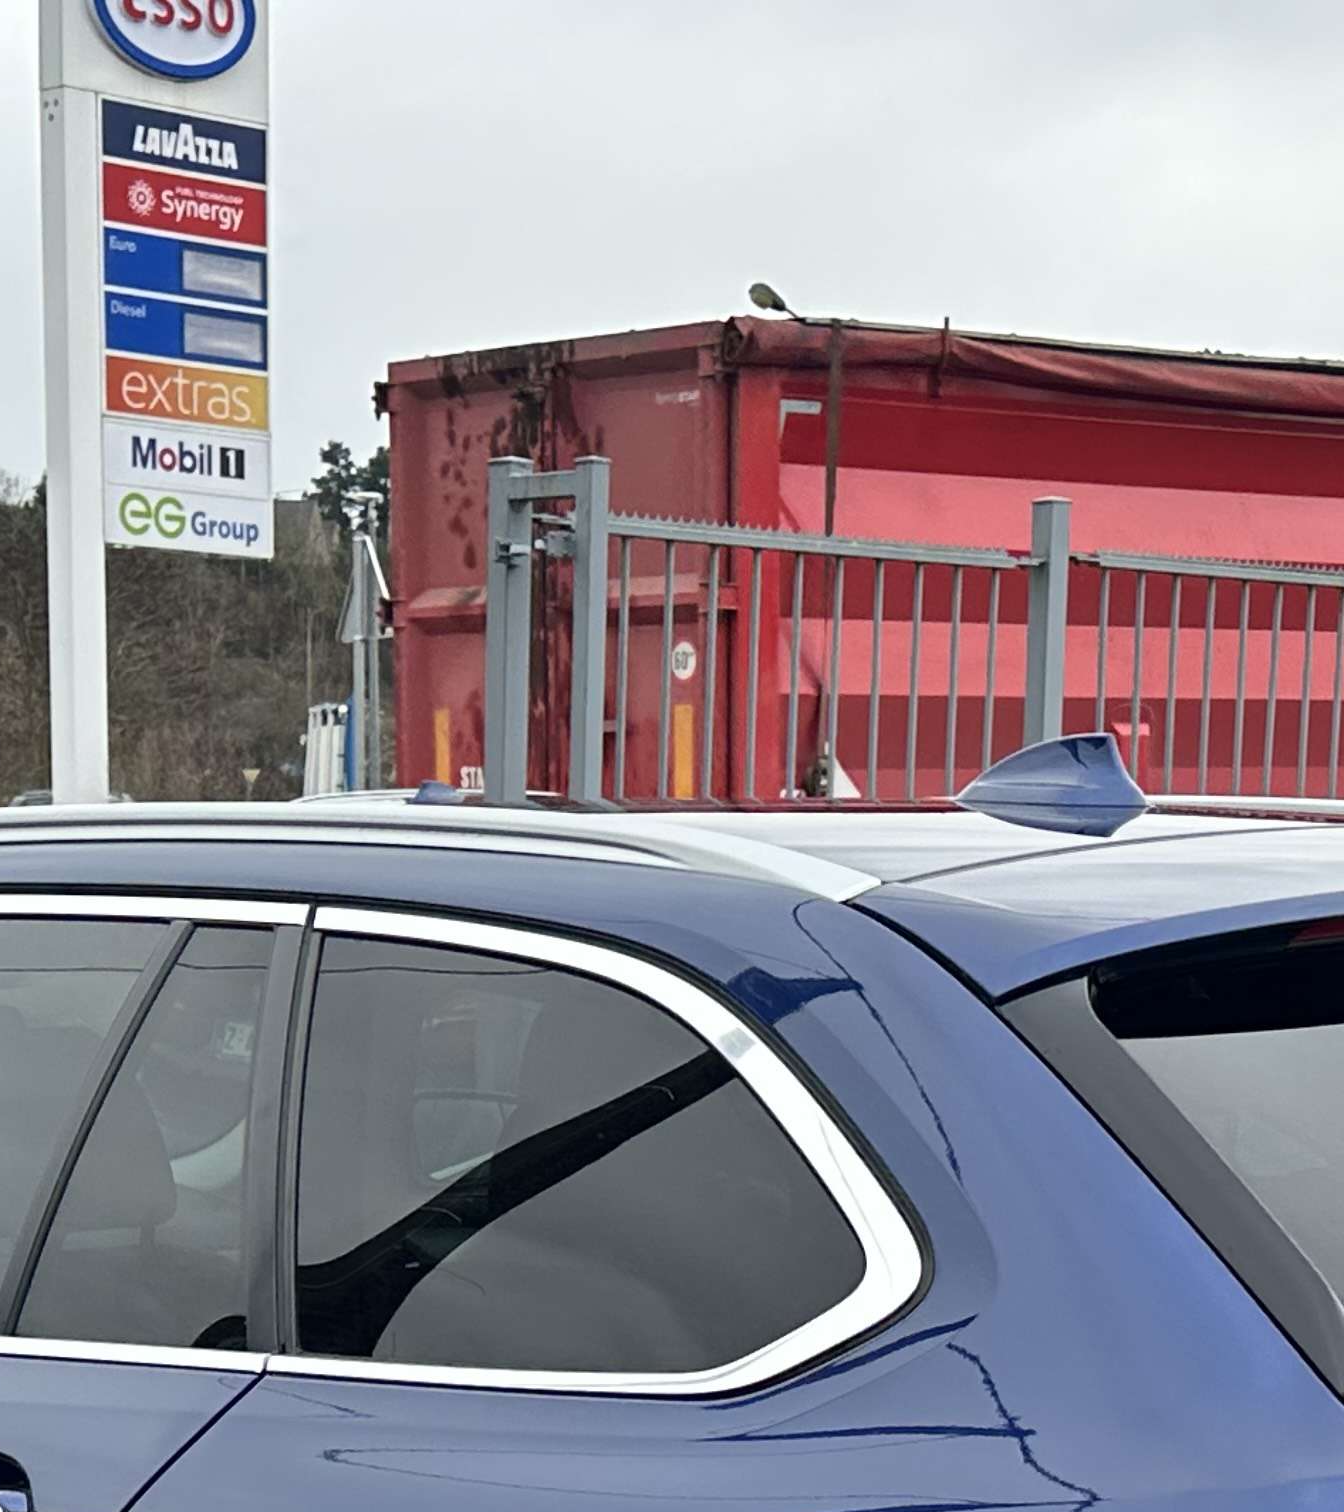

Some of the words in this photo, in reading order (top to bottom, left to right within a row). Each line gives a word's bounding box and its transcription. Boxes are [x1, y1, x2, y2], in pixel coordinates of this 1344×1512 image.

[133, 123, 238, 169] LAVAZZA
[161, 190, 244, 232] Synergy
[111, 300, 146, 318] Diesel
[122, 369, 251, 422] extras
[132, 436, 212, 476] Mobil
[191, 510, 259, 547] Group
